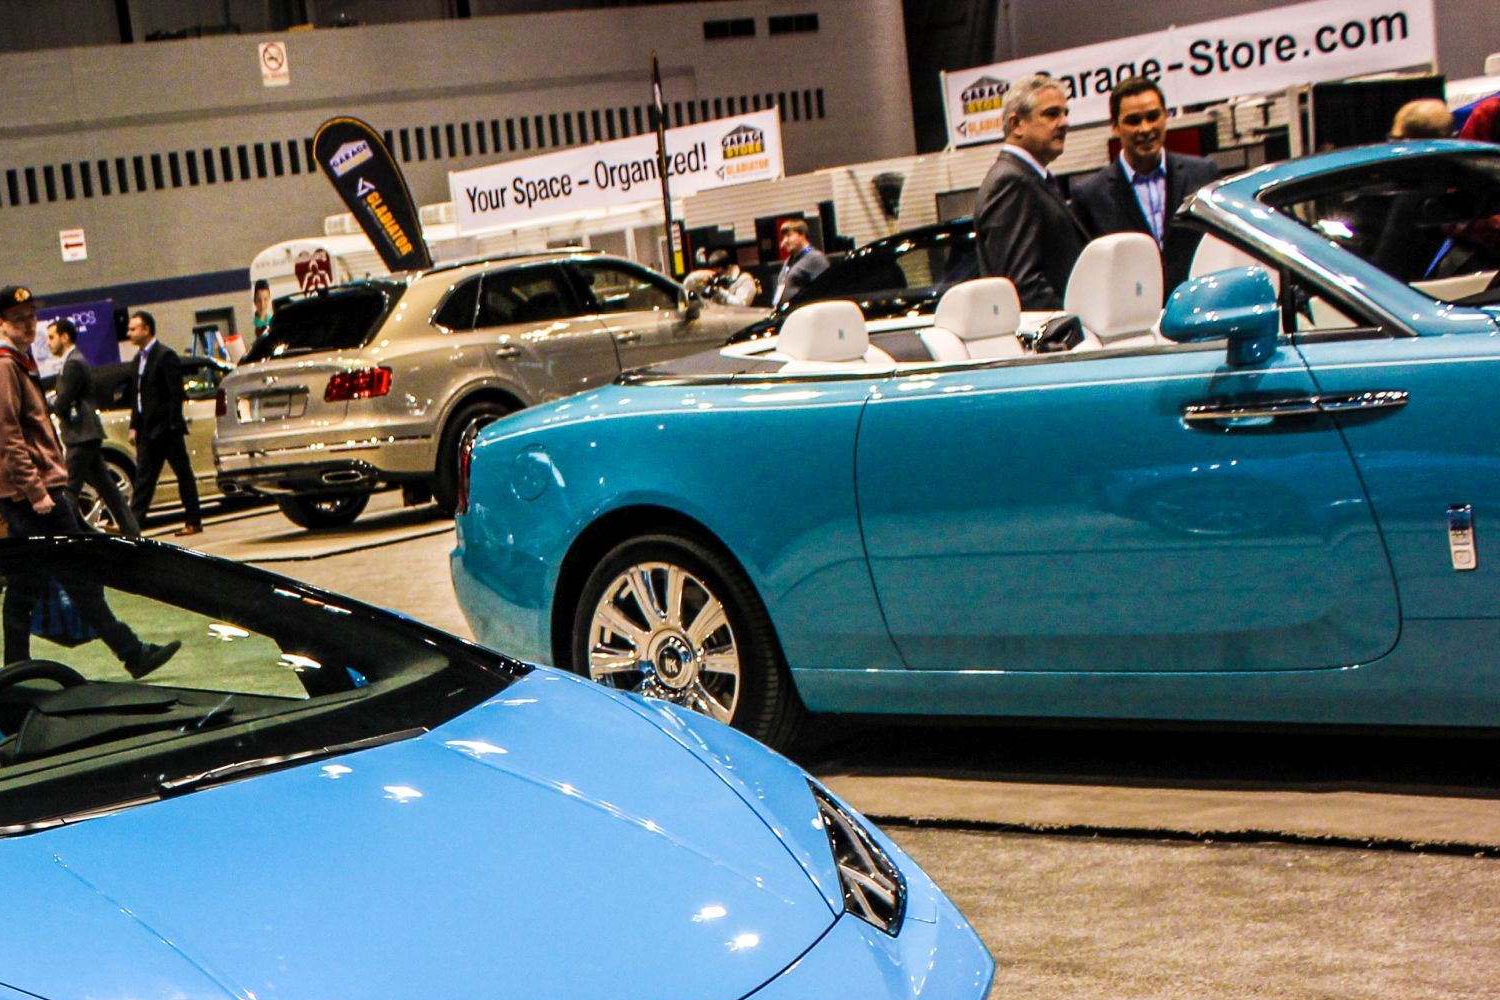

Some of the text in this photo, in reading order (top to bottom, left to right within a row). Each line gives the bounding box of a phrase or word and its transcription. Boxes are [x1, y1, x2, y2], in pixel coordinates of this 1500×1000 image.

[1034, 10, 1409, 102] arage-Store.com
[332, 142, 368, 168] GARAGE
[466, 186, 507, 213] Your
[512, 173, 573, 208] Space
[366, 191, 414, 257] GLADIATOR
